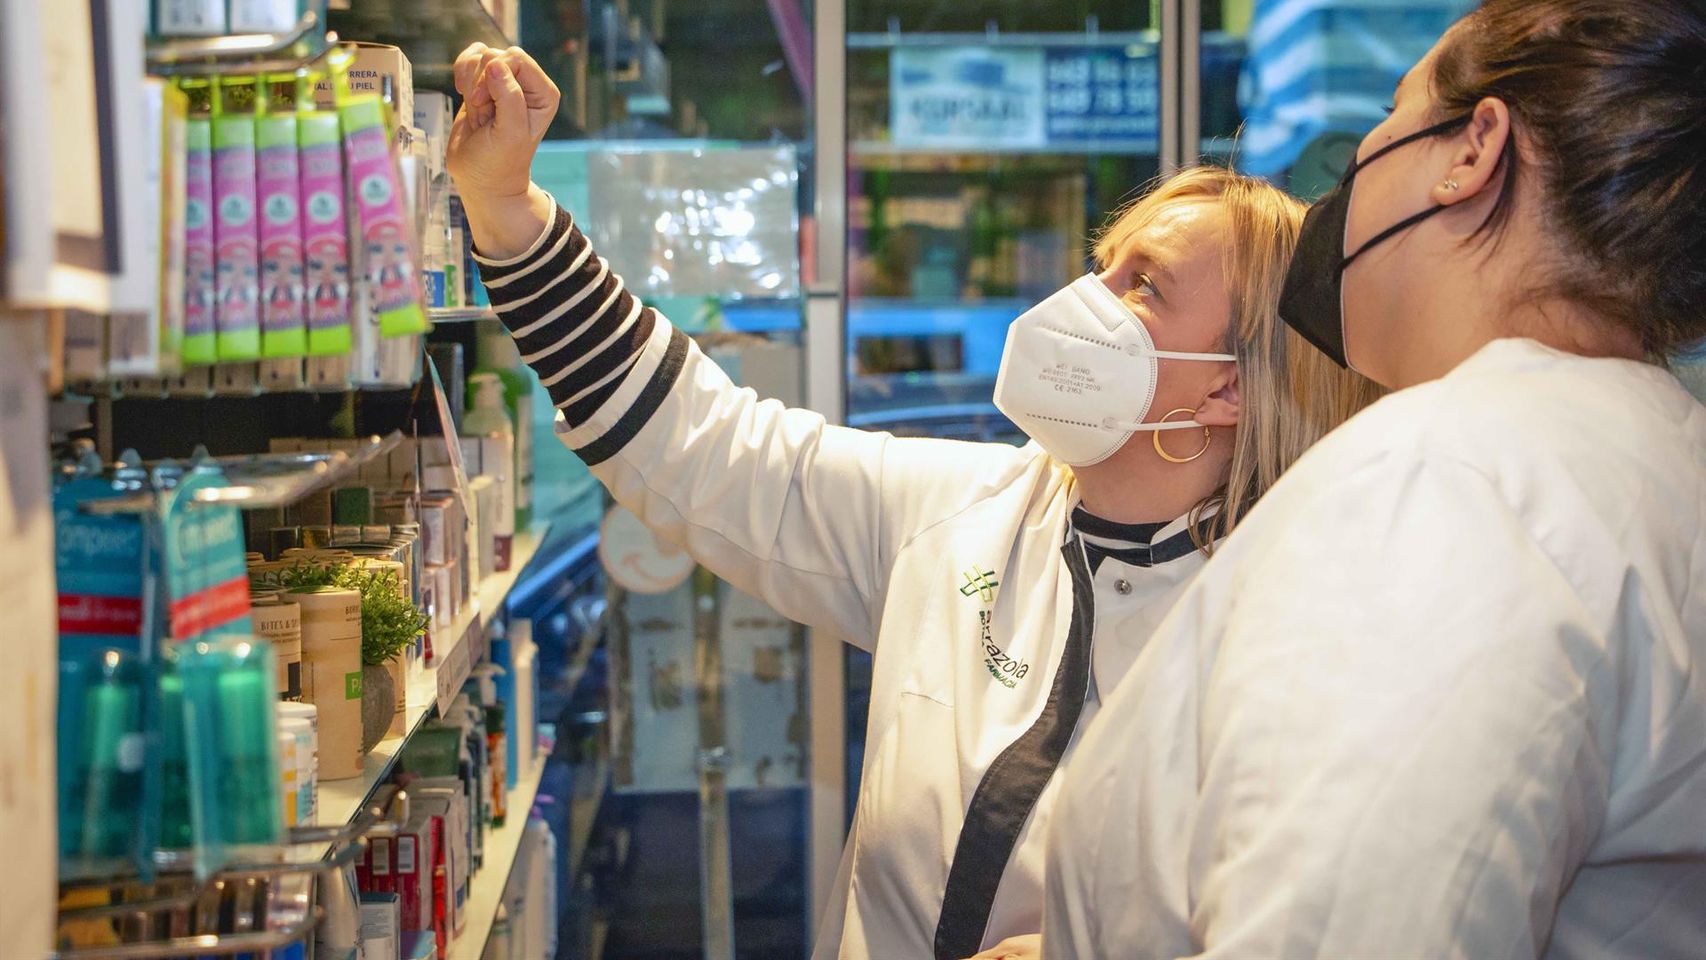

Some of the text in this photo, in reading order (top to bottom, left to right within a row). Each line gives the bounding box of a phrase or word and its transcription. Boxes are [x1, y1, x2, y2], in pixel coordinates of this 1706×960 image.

[349, 71, 378, 79] RRERA
[356, 82, 375, 90] PIEL
[261, 618, 284, 631] BITES
